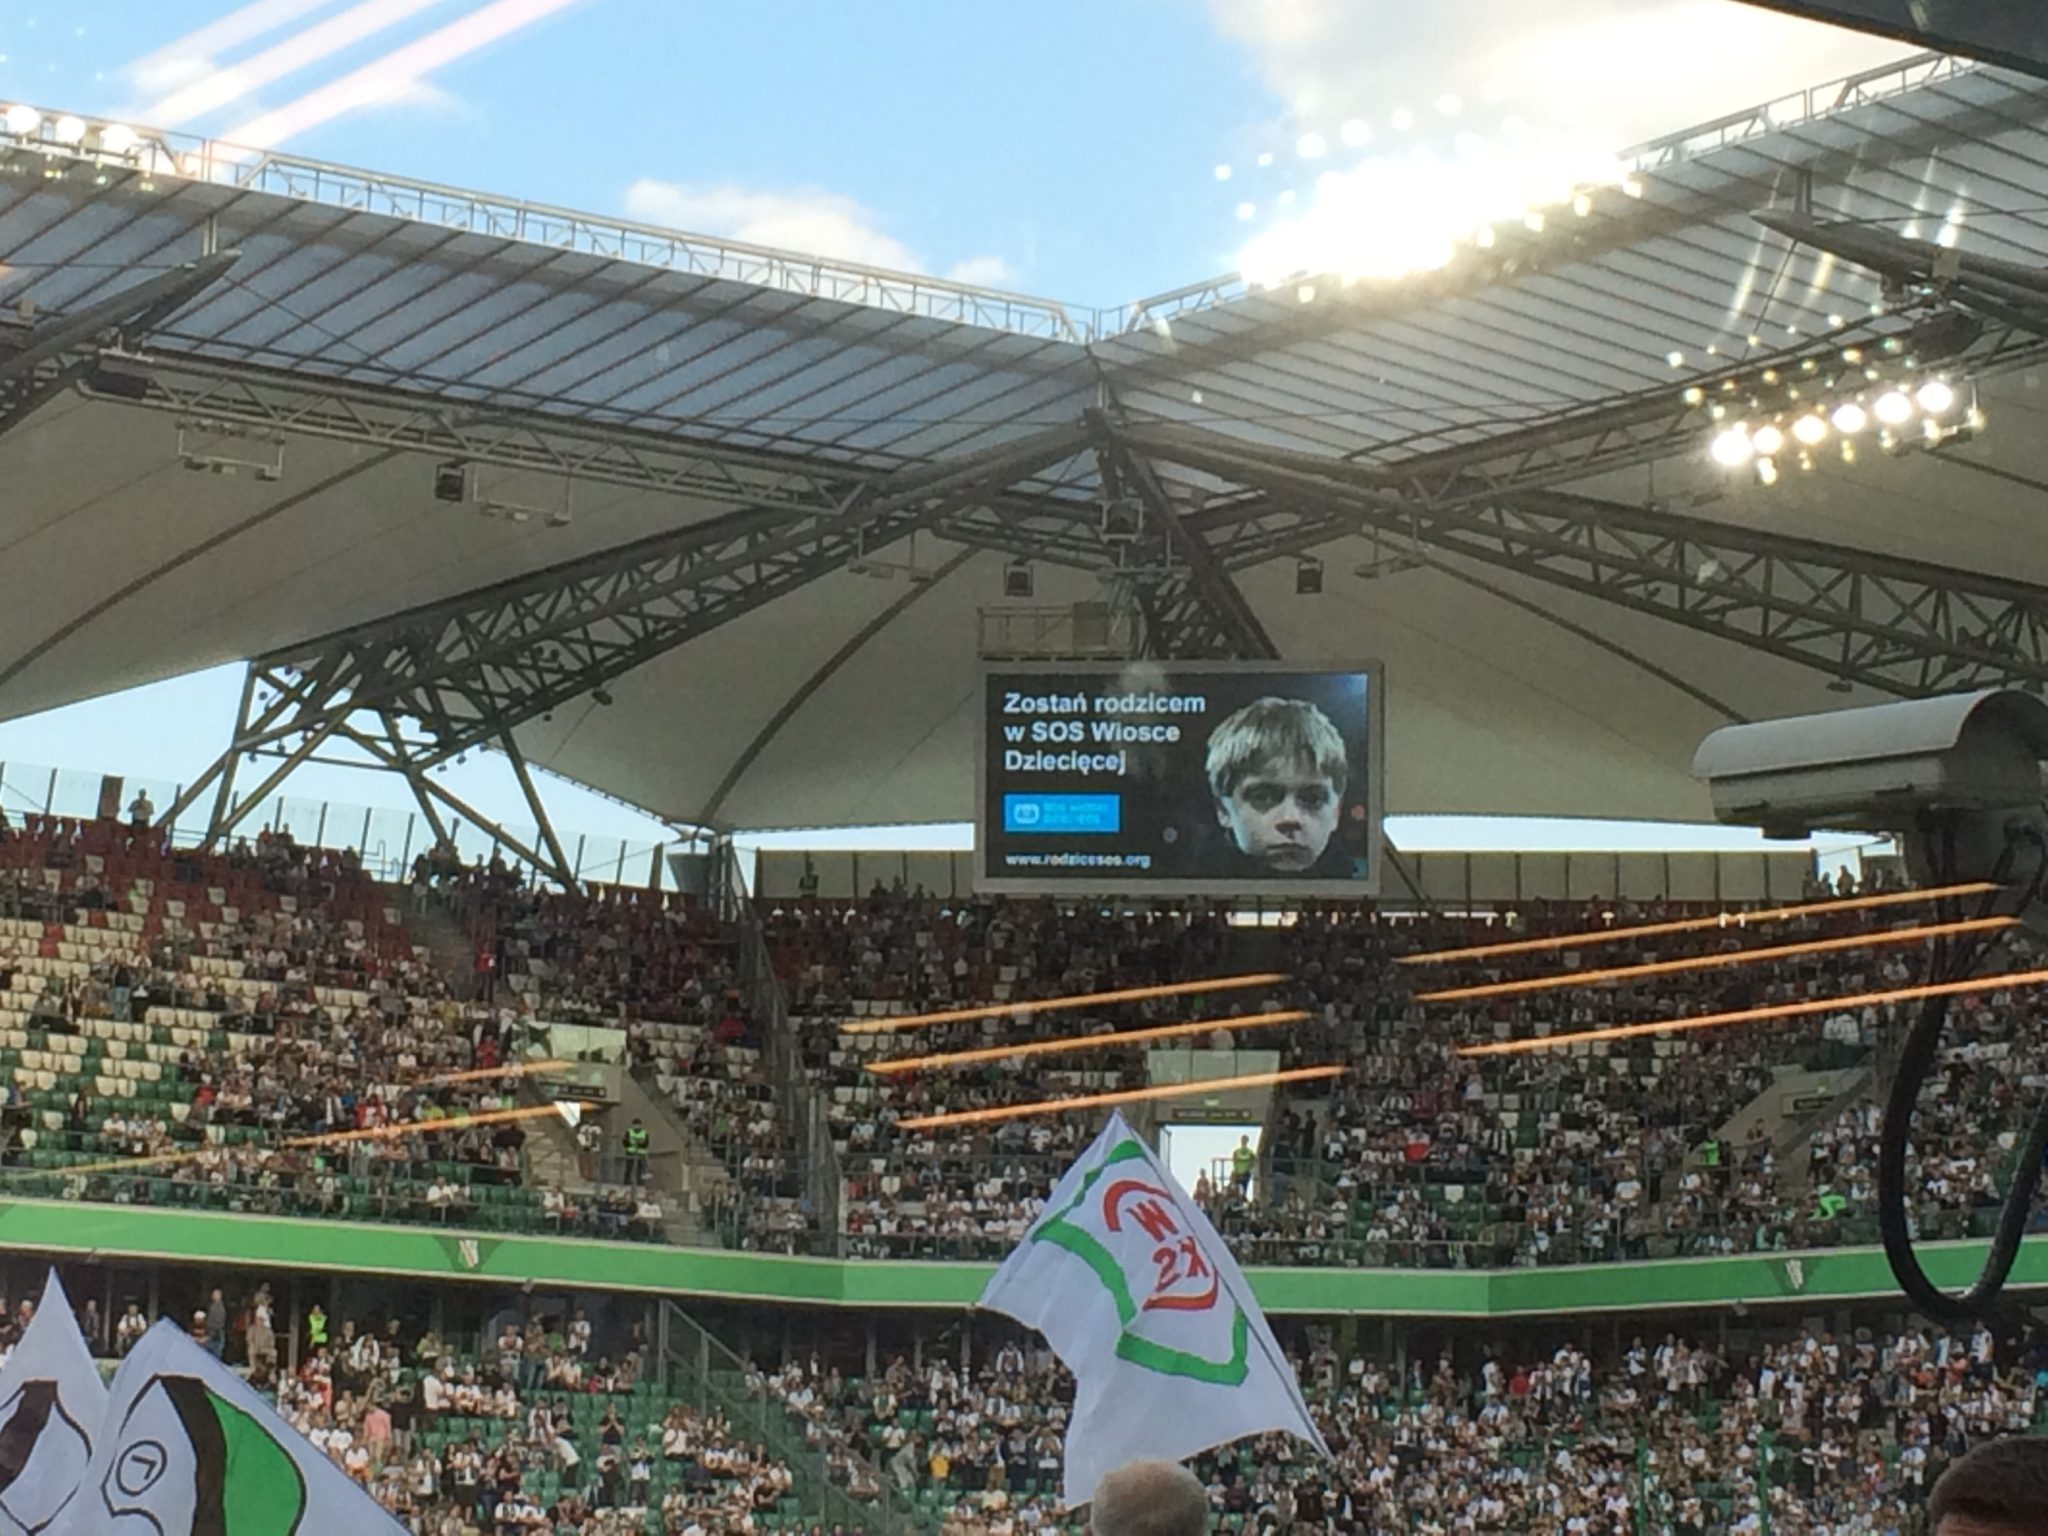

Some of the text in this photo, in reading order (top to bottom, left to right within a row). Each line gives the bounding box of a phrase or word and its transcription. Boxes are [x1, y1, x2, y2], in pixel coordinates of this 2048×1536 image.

[1003, 692, 1206, 713] Zostań rodzicem
[1004, 721, 1181, 742] w SOS Wiosce
[1004, 750, 1126, 776] Dziecięcej
